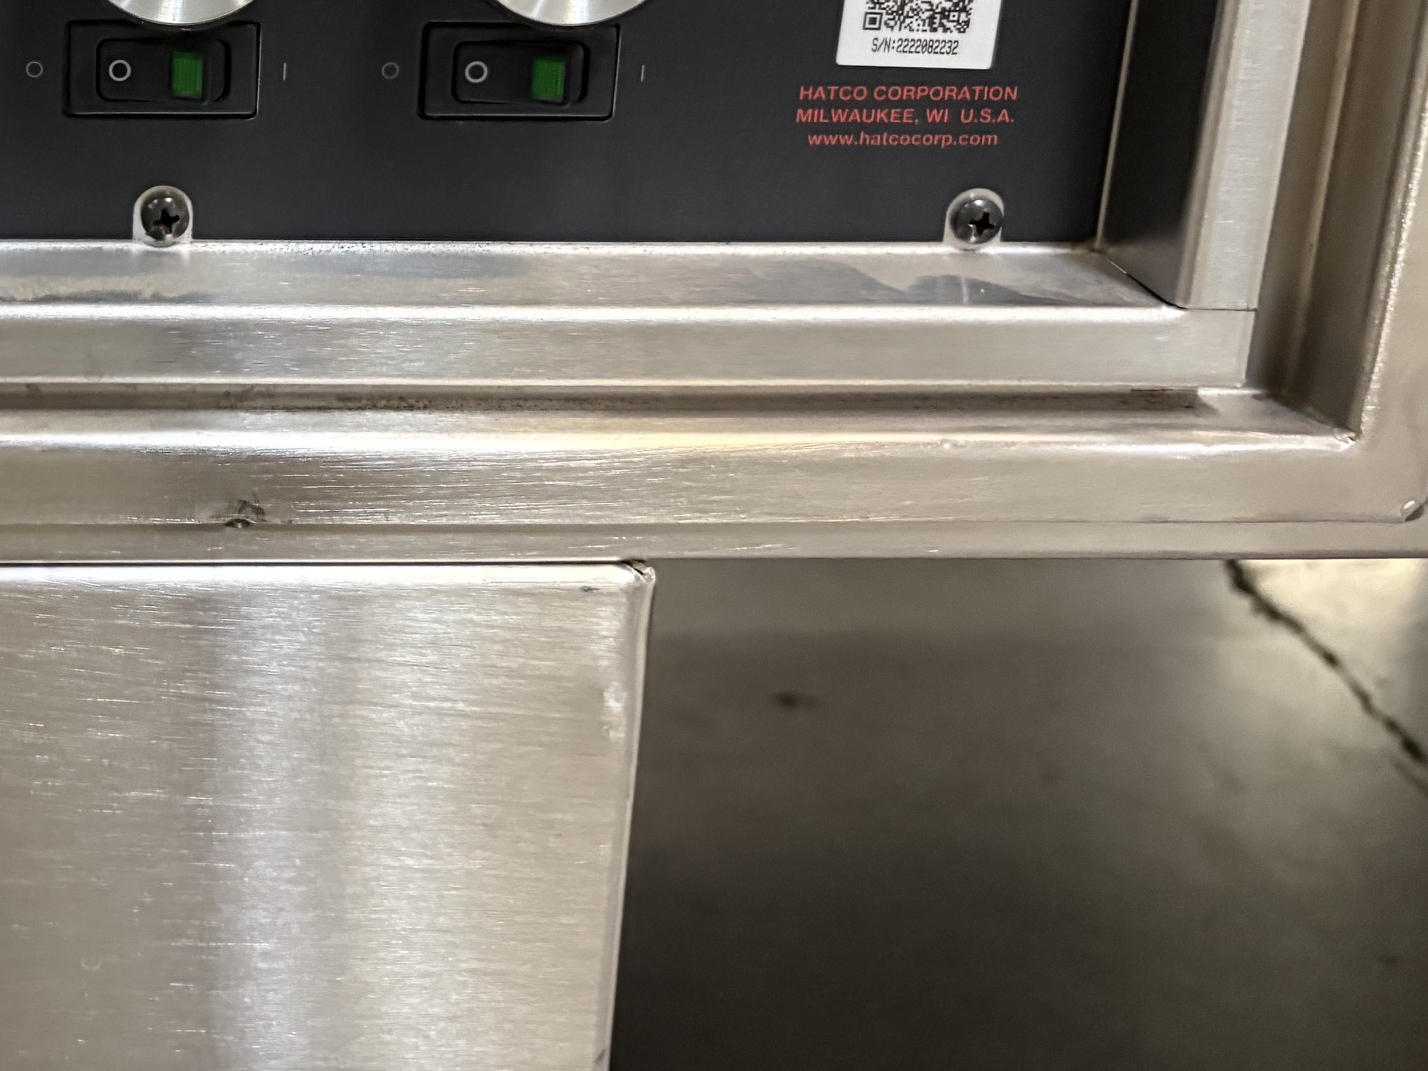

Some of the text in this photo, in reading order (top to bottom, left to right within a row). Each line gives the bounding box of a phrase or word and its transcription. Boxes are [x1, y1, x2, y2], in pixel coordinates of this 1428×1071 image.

[800, 86, 1017, 100] HATCO CORPORATION
[796, 109, 1013, 124] MILWAUKEE, WI U.S.A.
[808, 132, 997, 148] www.hatcocorp.com
